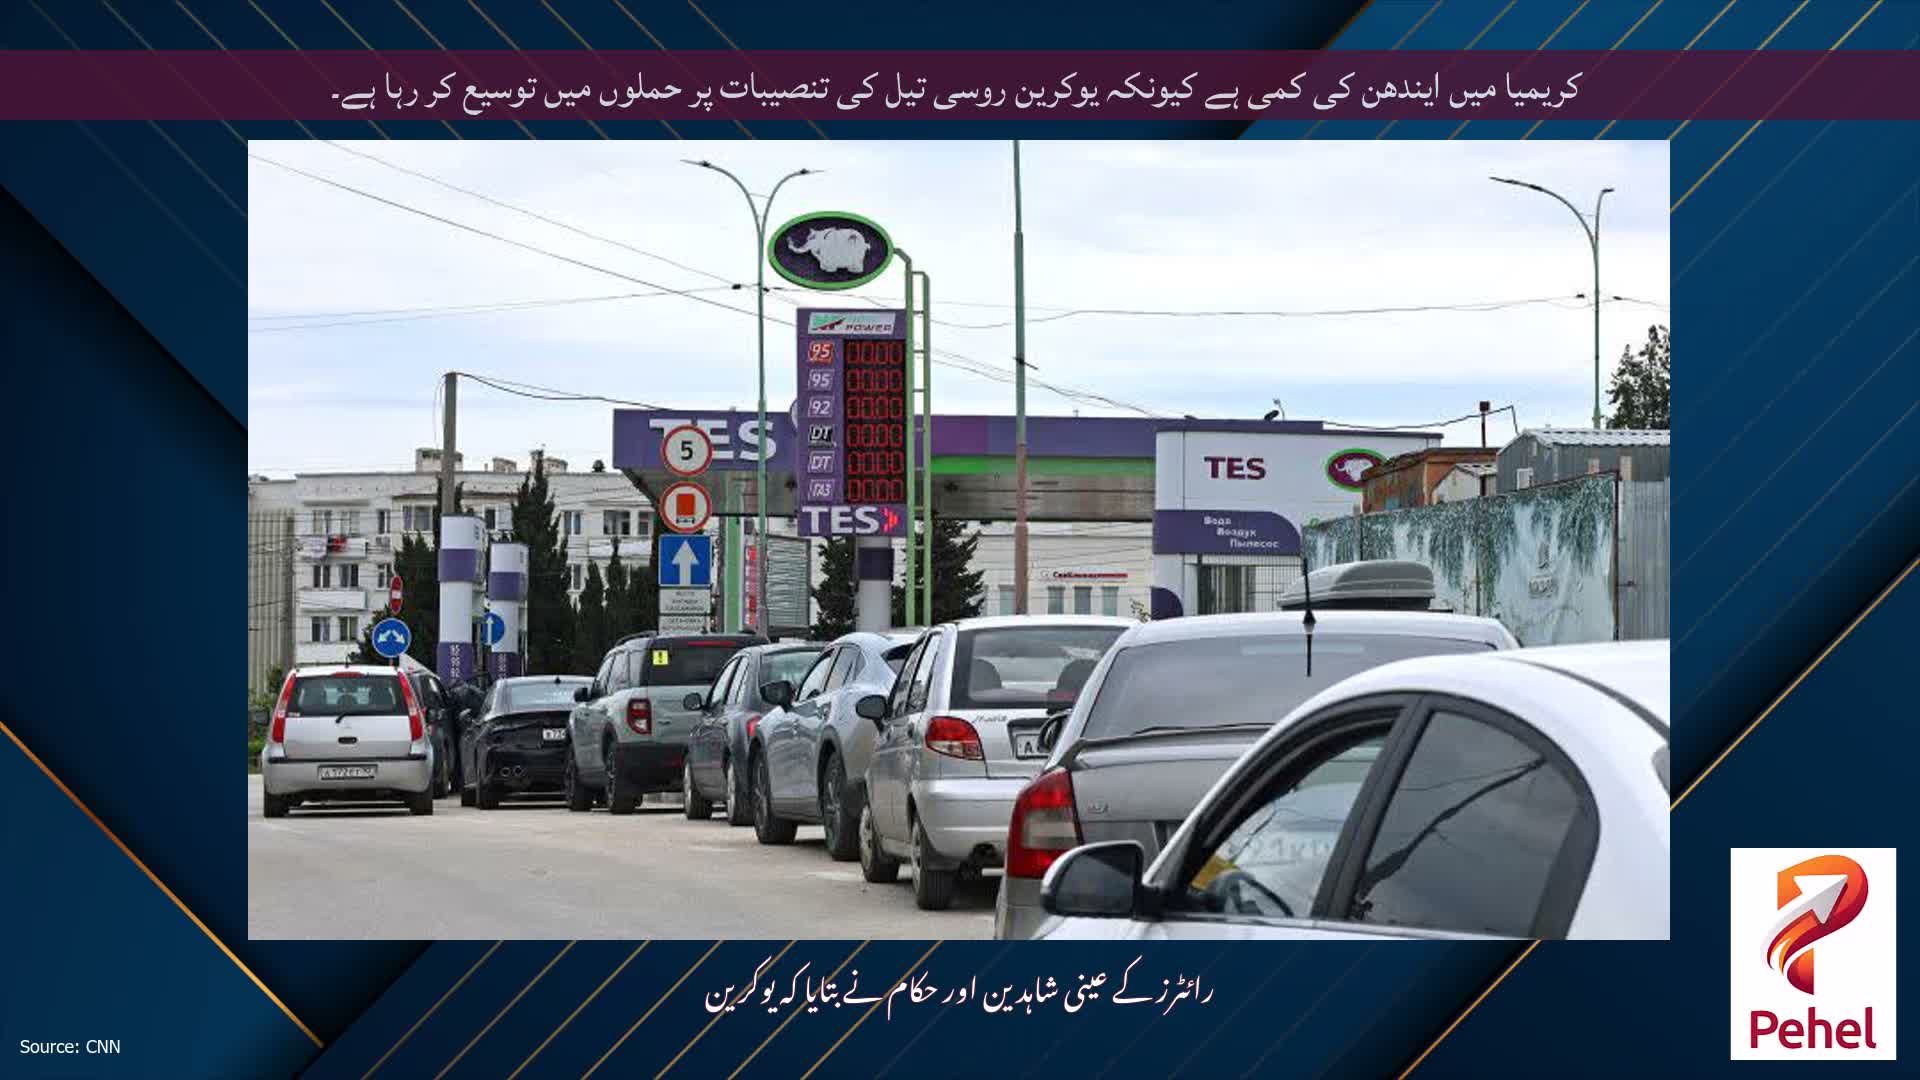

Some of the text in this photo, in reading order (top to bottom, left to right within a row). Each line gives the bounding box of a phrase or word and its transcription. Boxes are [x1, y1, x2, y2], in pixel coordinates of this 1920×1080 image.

[811, 343, 831, 359] 95
[812, 373, 831, 388] 95
[812, 400, 832, 415] 92
[649, 418, 778, 462] TES
[680, 440, 694, 461] 5
[811, 455, 832, 471] DT
[1203, 455, 1267, 481] TES
[801, 505, 880, 535] TES
[1203, 515, 1232, 527] Вода
[1229, 538, 1280, 549] Пылесос
